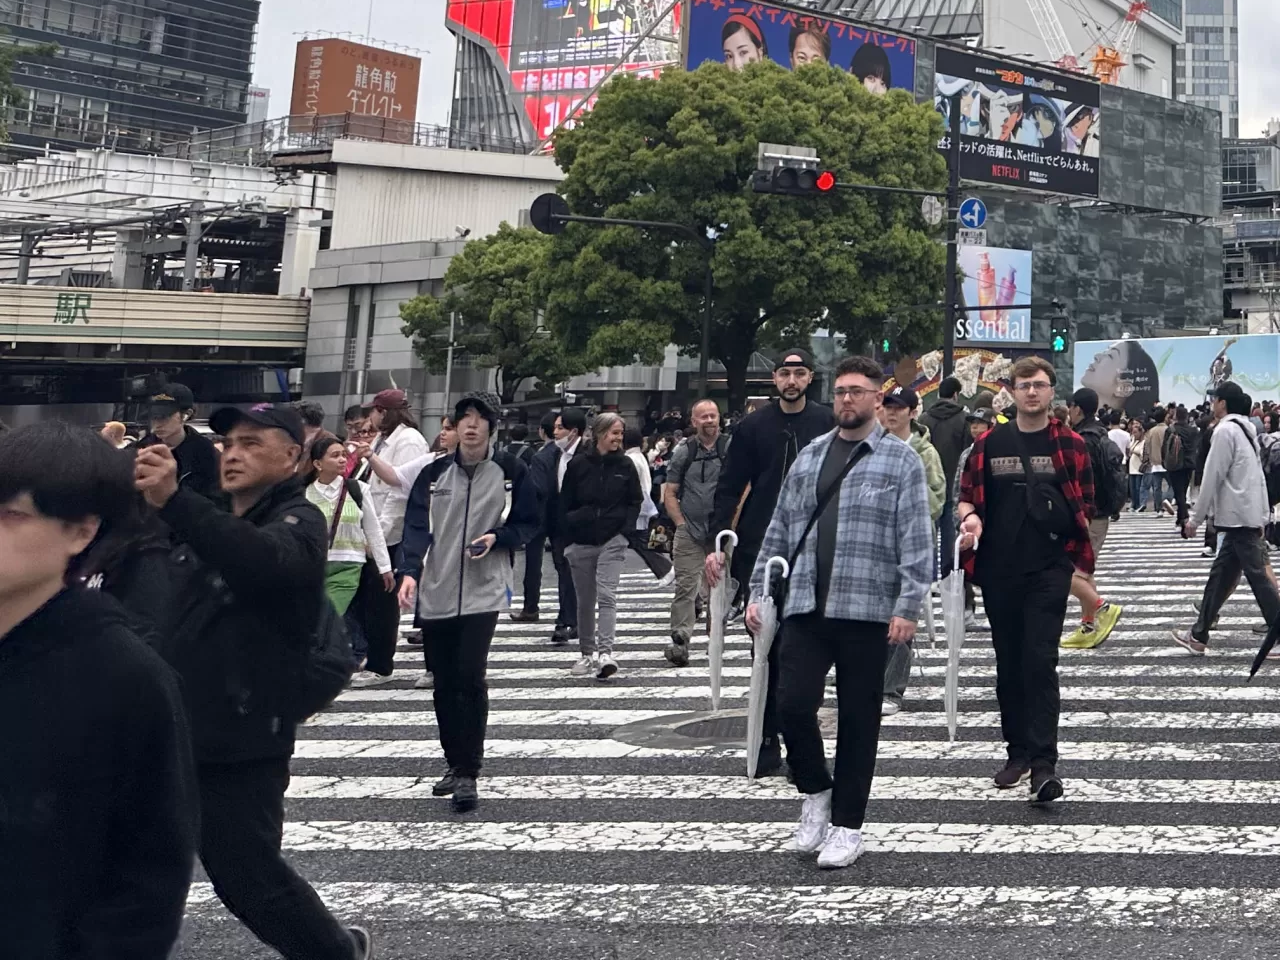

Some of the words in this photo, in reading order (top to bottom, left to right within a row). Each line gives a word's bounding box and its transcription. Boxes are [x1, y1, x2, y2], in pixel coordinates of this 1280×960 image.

[355, 63, 397, 94] 龍角散
[347, 89, 402, 118] ダイレクト
[992, 165, 1020, 179] NETFLIX
[53, 292, 92, 325] 駅
[956, 315, 1025, 339] ssential
